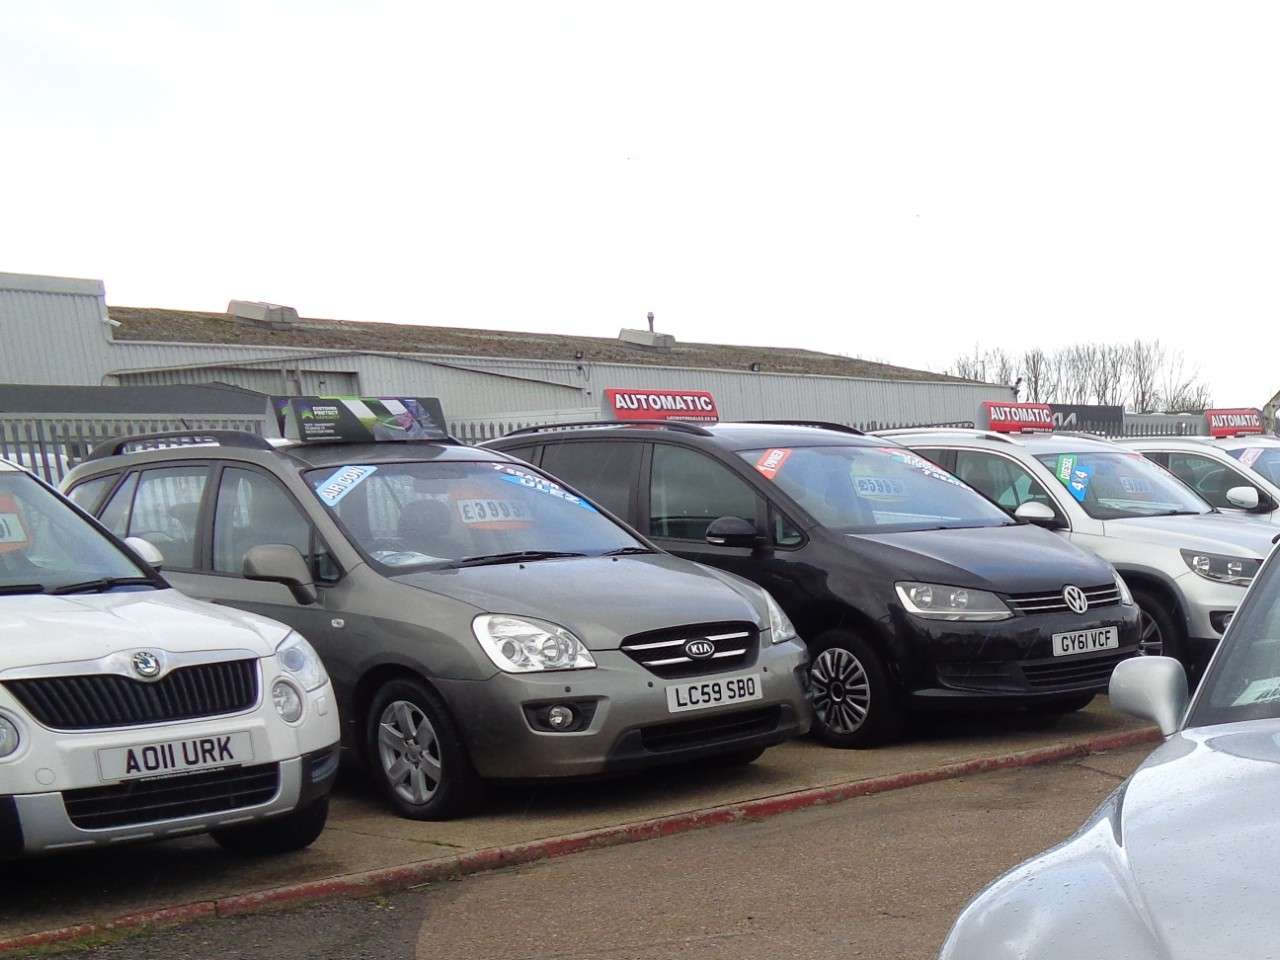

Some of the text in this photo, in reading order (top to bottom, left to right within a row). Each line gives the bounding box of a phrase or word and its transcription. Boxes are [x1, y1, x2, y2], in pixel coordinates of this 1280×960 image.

[615, 393, 713, 410] AUTOMATIC
[990, 406, 1051, 422] AUTOMATIC
[1211, 414, 1260, 427] AUTOMATIC
[1060, 457, 1073, 480] DIESEL
[323, 481, 346, 501] AIR
[690, 643, 712, 654] KIA
[1061, 630, 1111, 652] GY61 VCF
[676, 677, 755, 707] LC59 SBO
[126, 743, 176, 774] AO11
[182, 736, 234, 766] URK
